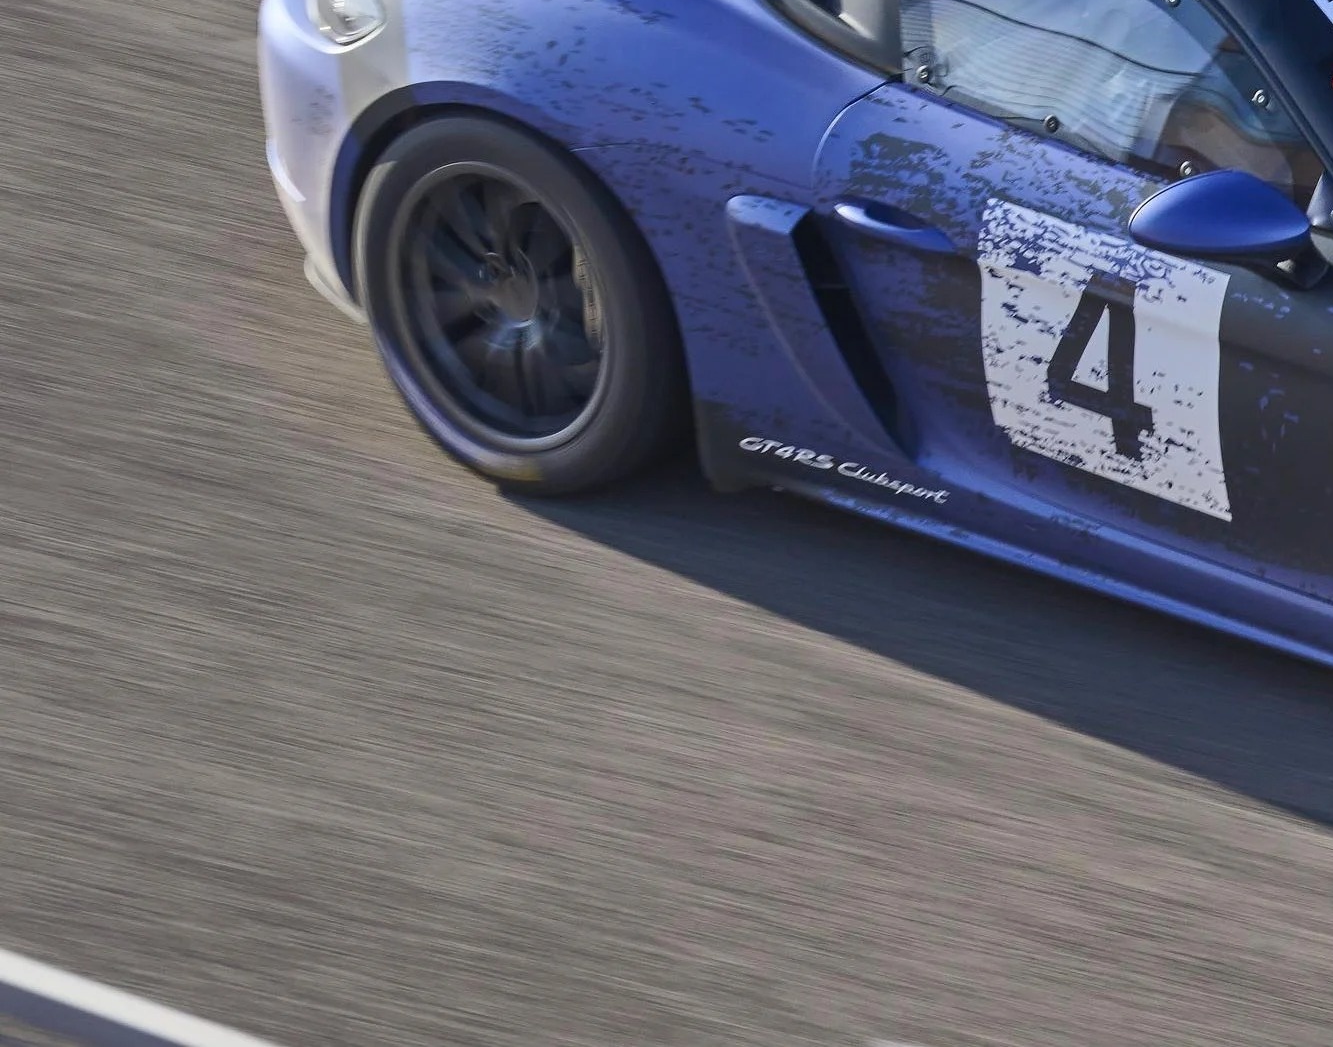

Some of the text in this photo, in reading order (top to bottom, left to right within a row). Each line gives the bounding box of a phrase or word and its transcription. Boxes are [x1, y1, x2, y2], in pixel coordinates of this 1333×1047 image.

[1046, 272, 1154, 462] 4
[738, 435, 951, 504] GT4RS Clubsport
